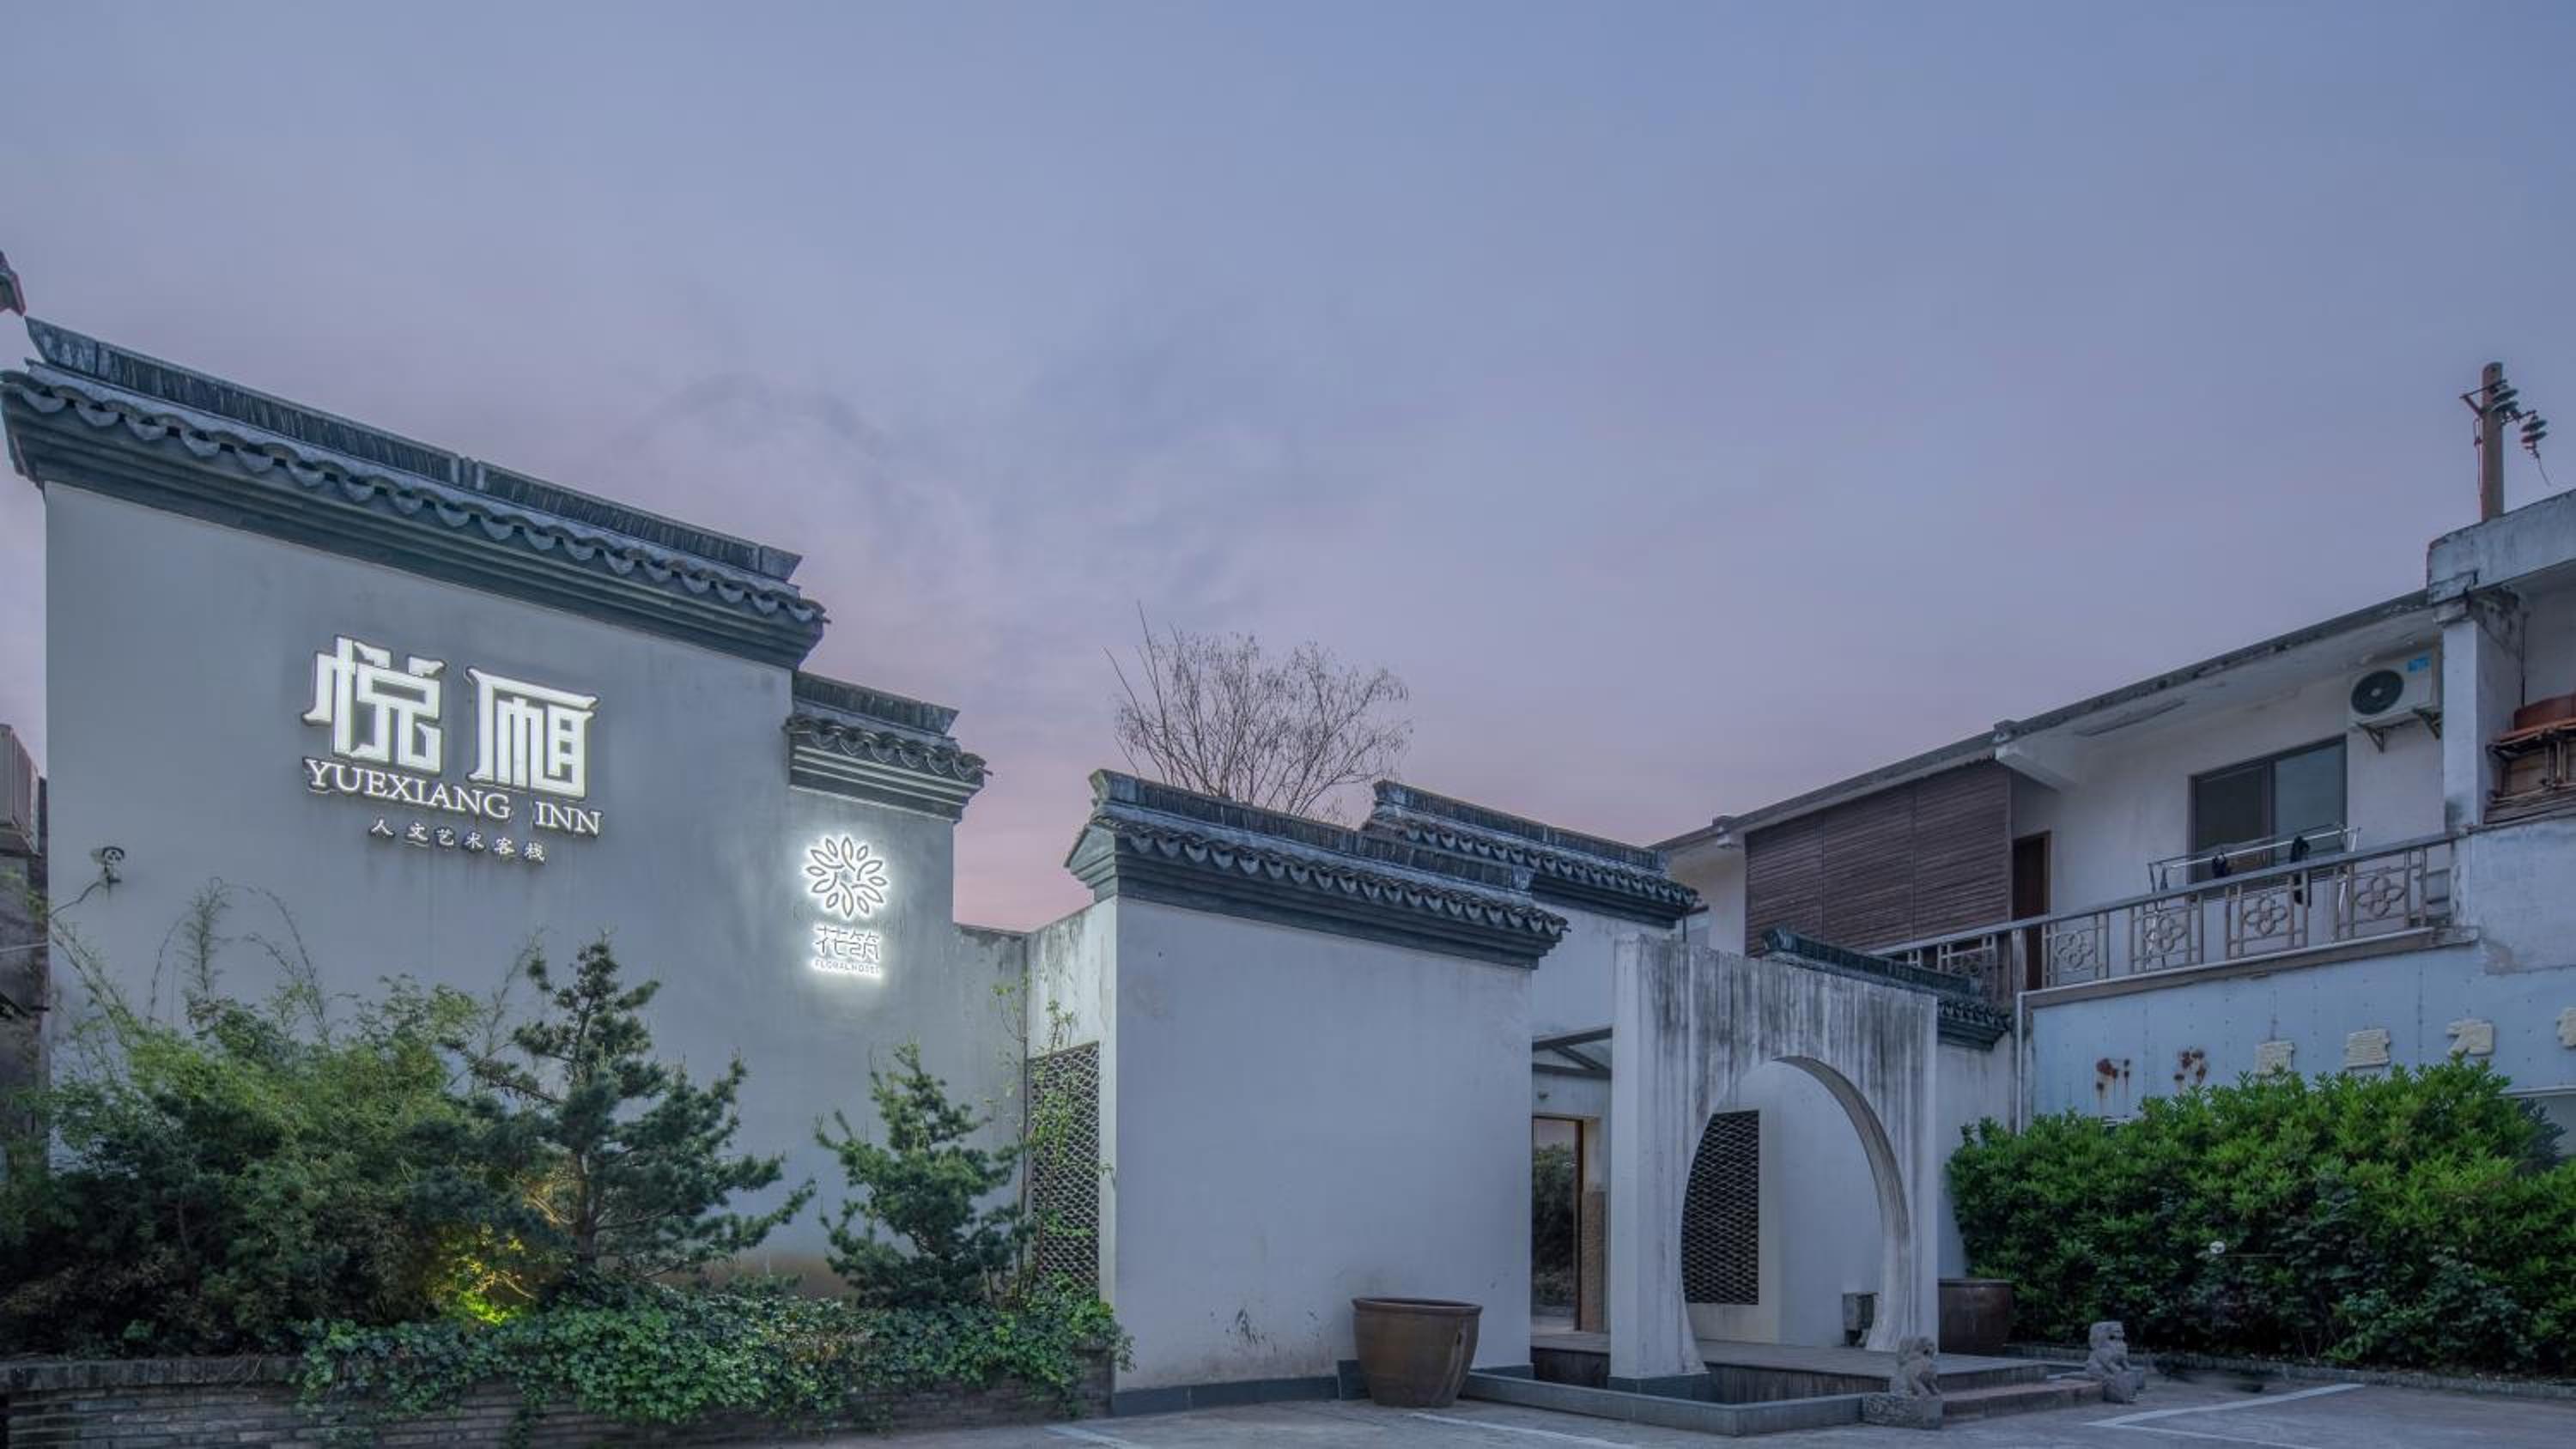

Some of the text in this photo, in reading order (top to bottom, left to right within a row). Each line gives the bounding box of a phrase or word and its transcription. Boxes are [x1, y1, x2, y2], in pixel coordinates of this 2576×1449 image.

[305, 758, 602, 836] YUEXIANG INN
[369, 818, 546, 862] 人文艺术客栈
[815, 925, 879, 959] 花筑
